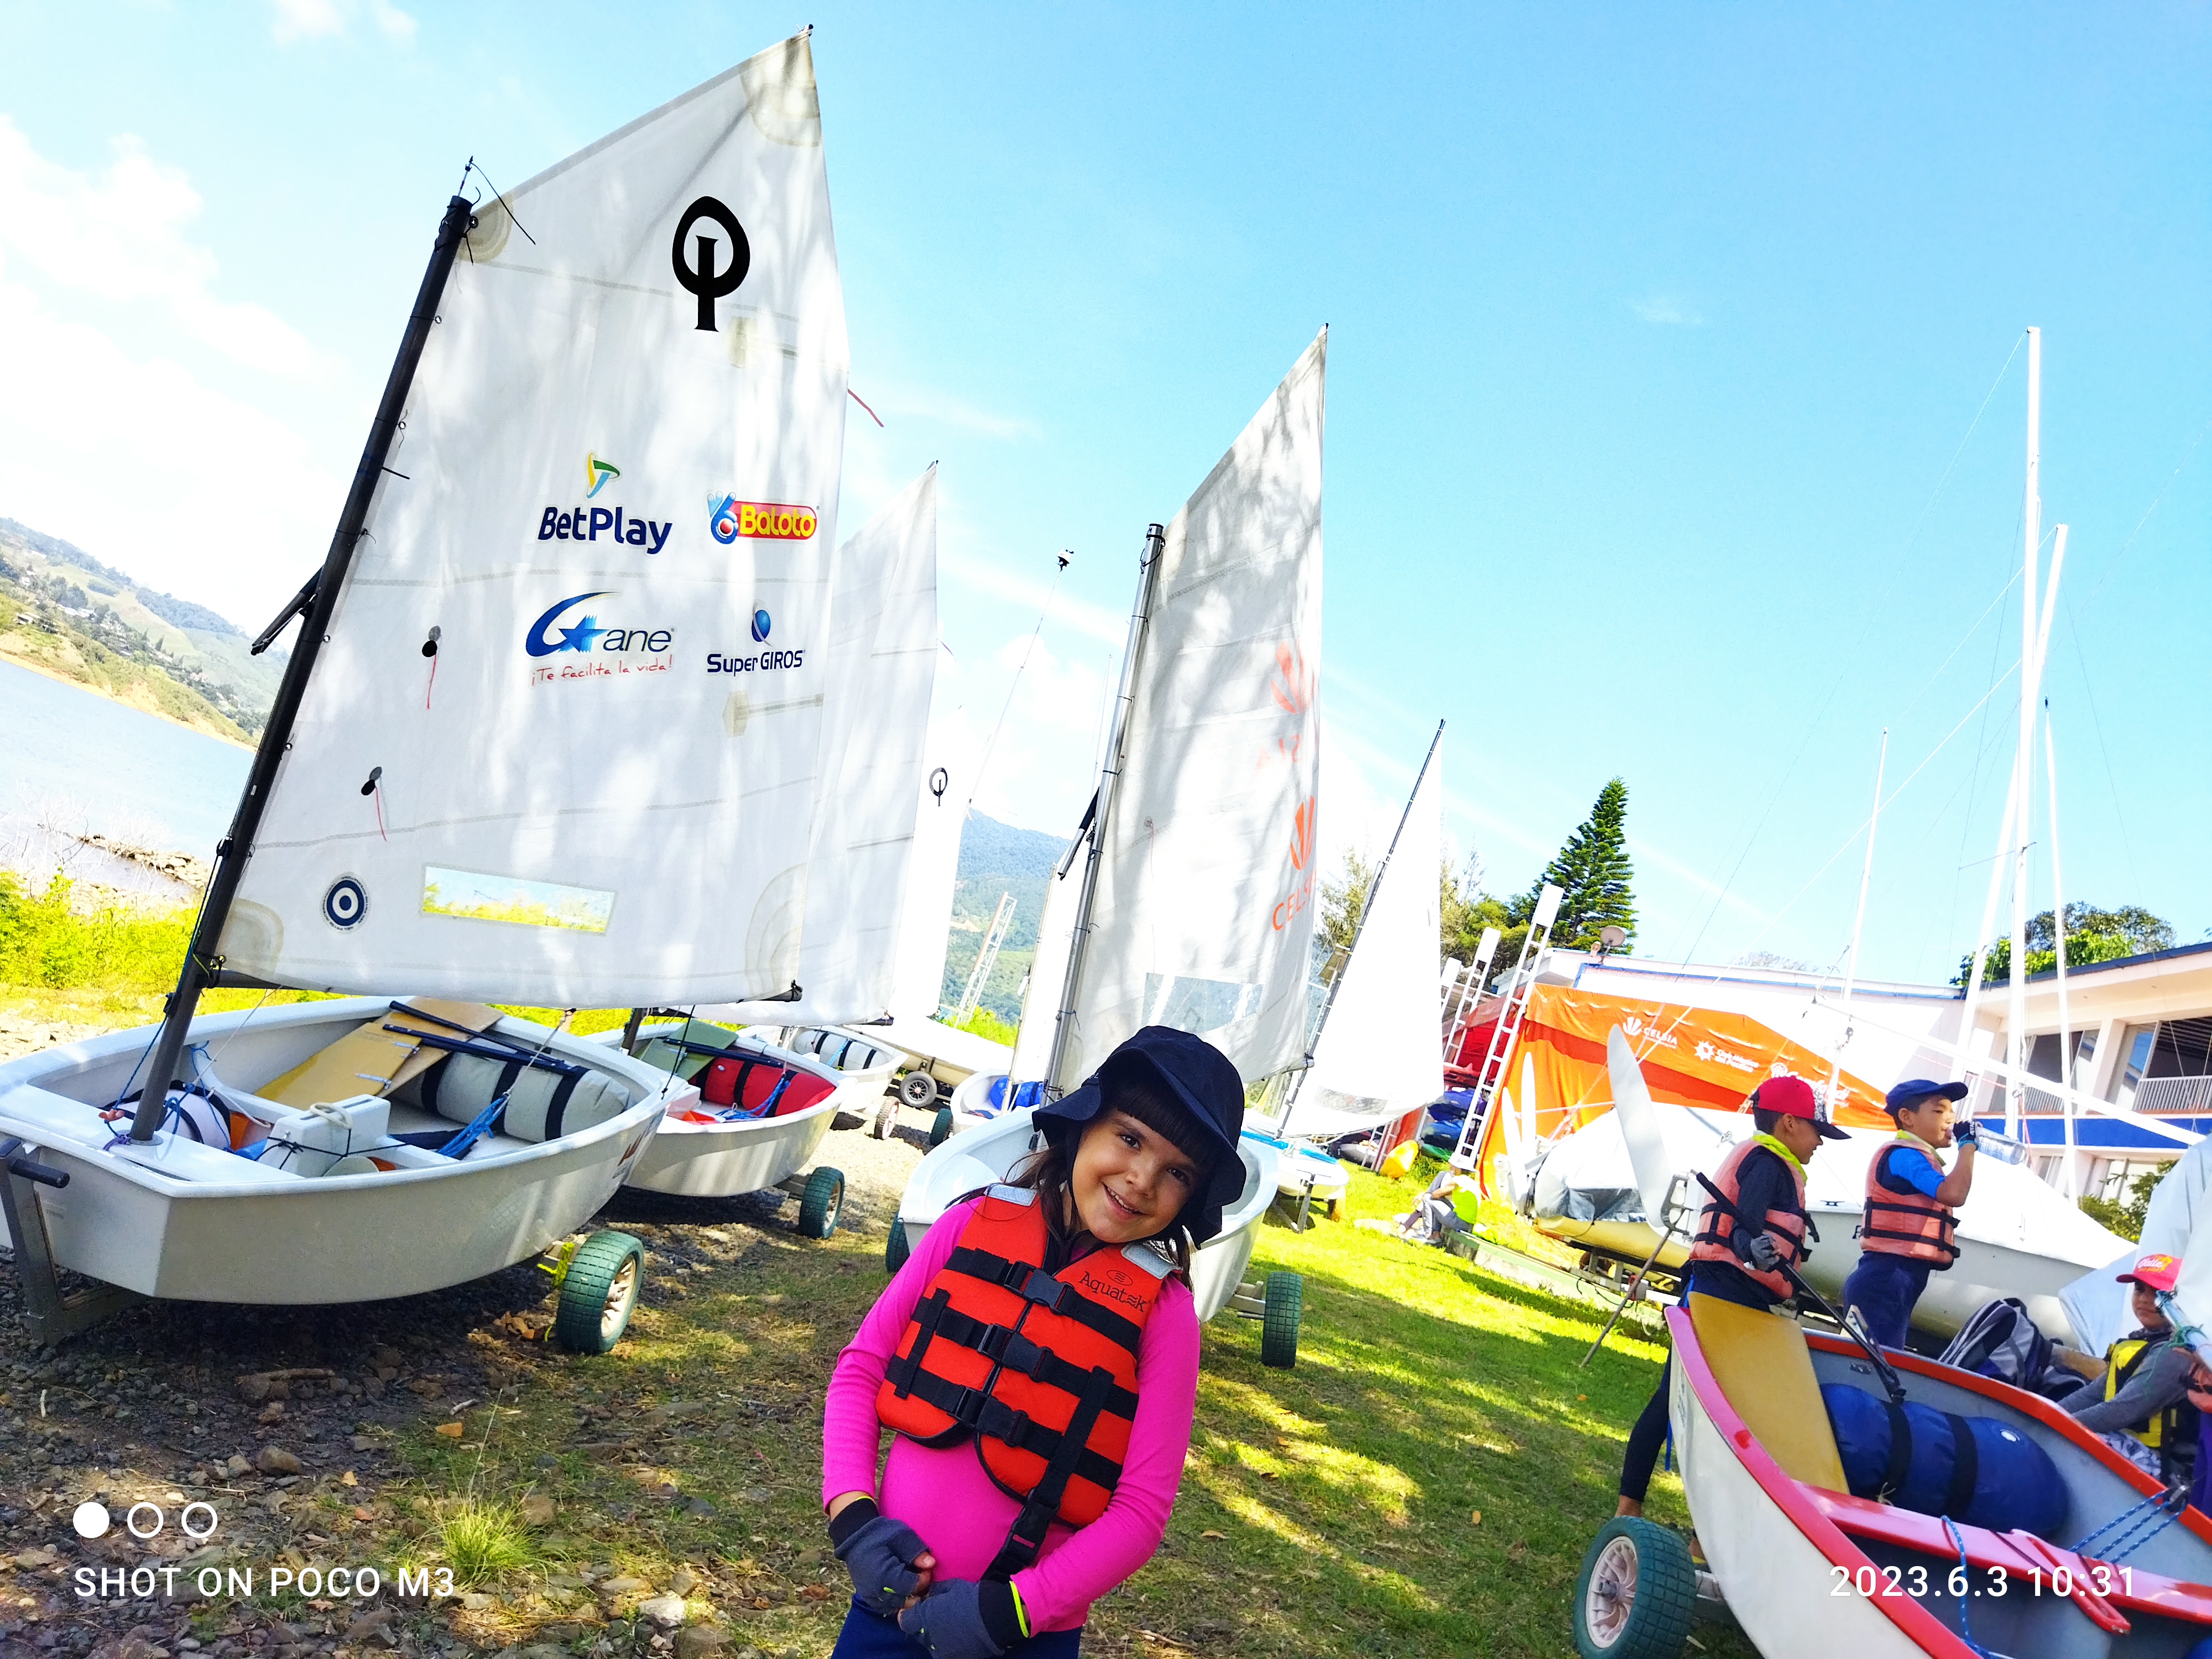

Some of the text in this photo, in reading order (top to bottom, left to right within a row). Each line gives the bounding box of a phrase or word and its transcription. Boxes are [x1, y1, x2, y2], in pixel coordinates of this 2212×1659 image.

[538, 506, 673, 555] BetPlay
[739, 504, 816, 538] Baloto
[561, 661, 612, 679] facilita
[618, 660, 630, 674] la
[637, 654, 673, 672] vida!
[707, 650, 804, 677] Super GIROS
[1078, 1270, 1147, 1313] Aquatek
